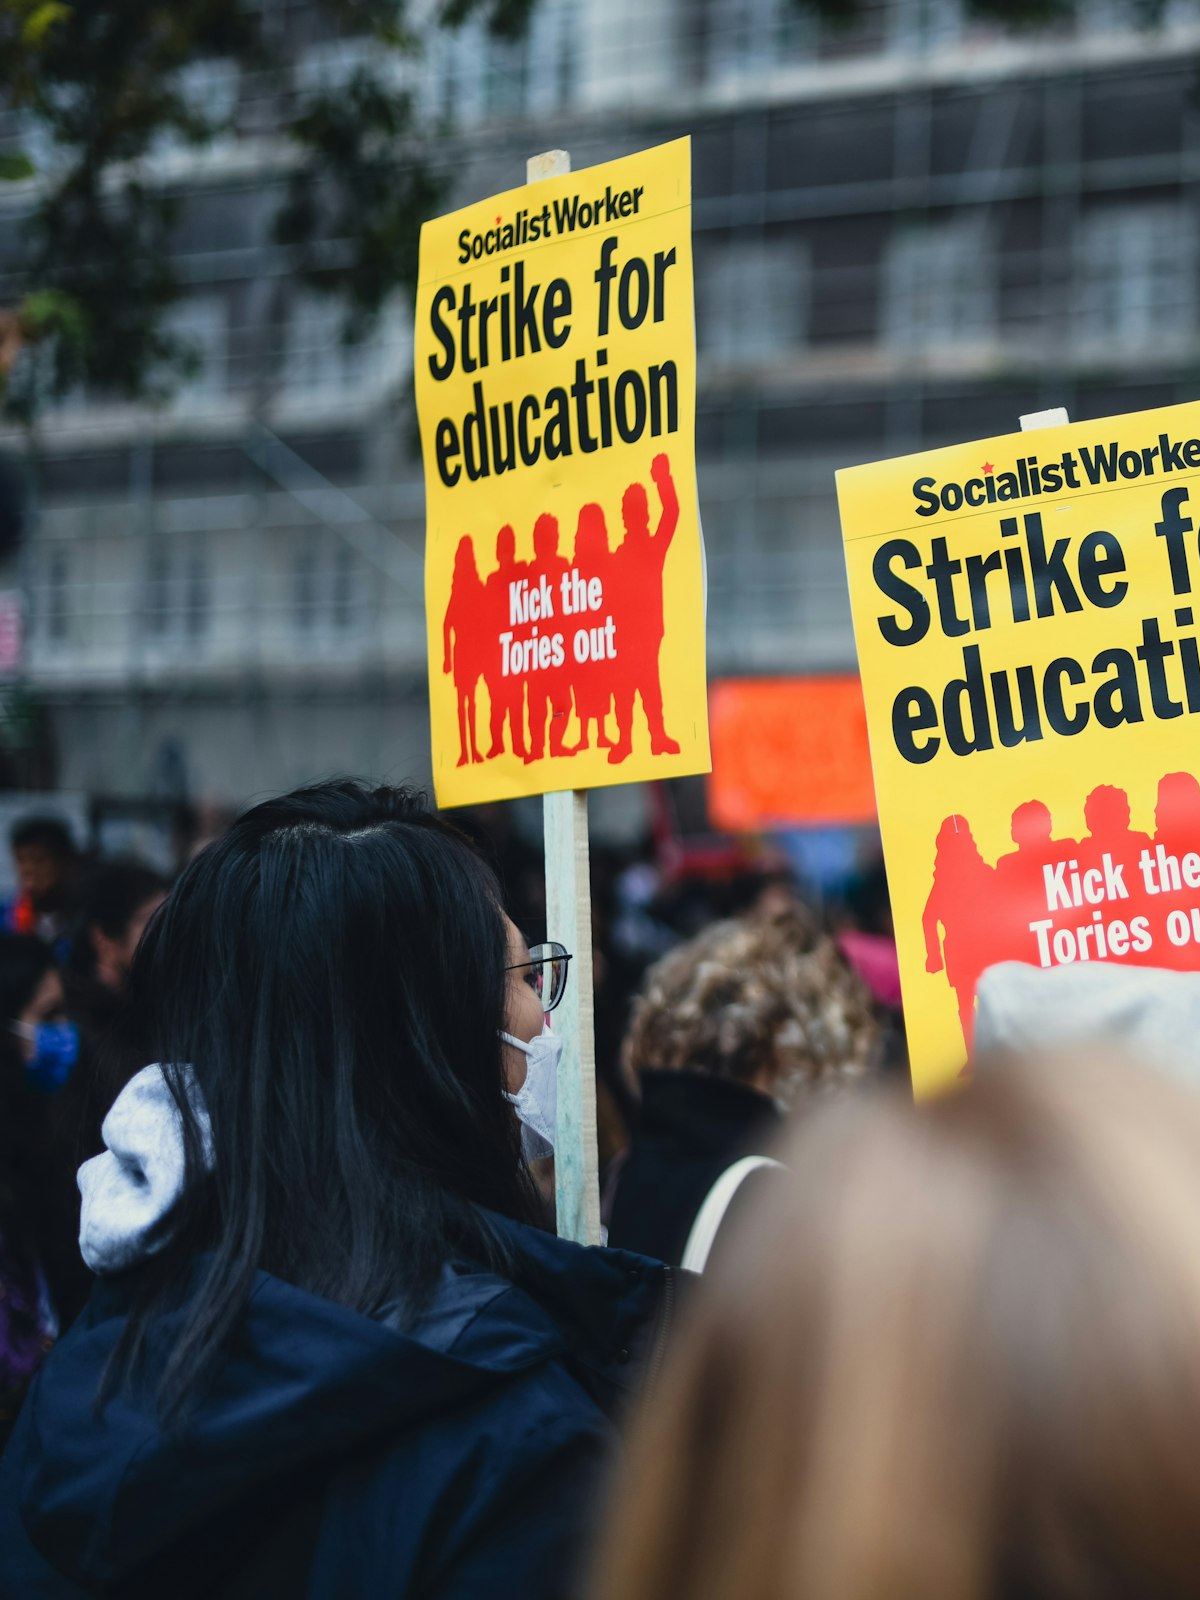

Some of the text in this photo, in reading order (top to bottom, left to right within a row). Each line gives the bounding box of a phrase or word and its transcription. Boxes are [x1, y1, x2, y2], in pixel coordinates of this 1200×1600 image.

[428, 236, 678, 382] Strike for
[435, 348, 679, 488] education
[508, 567, 603, 626] Kick the
[872, 511, 1129, 647] Strike
[498, 615, 618, 677] Tories out
[1042, 852, 1130, 912] Kick
[1029, 910, 1153, 968] Tories
